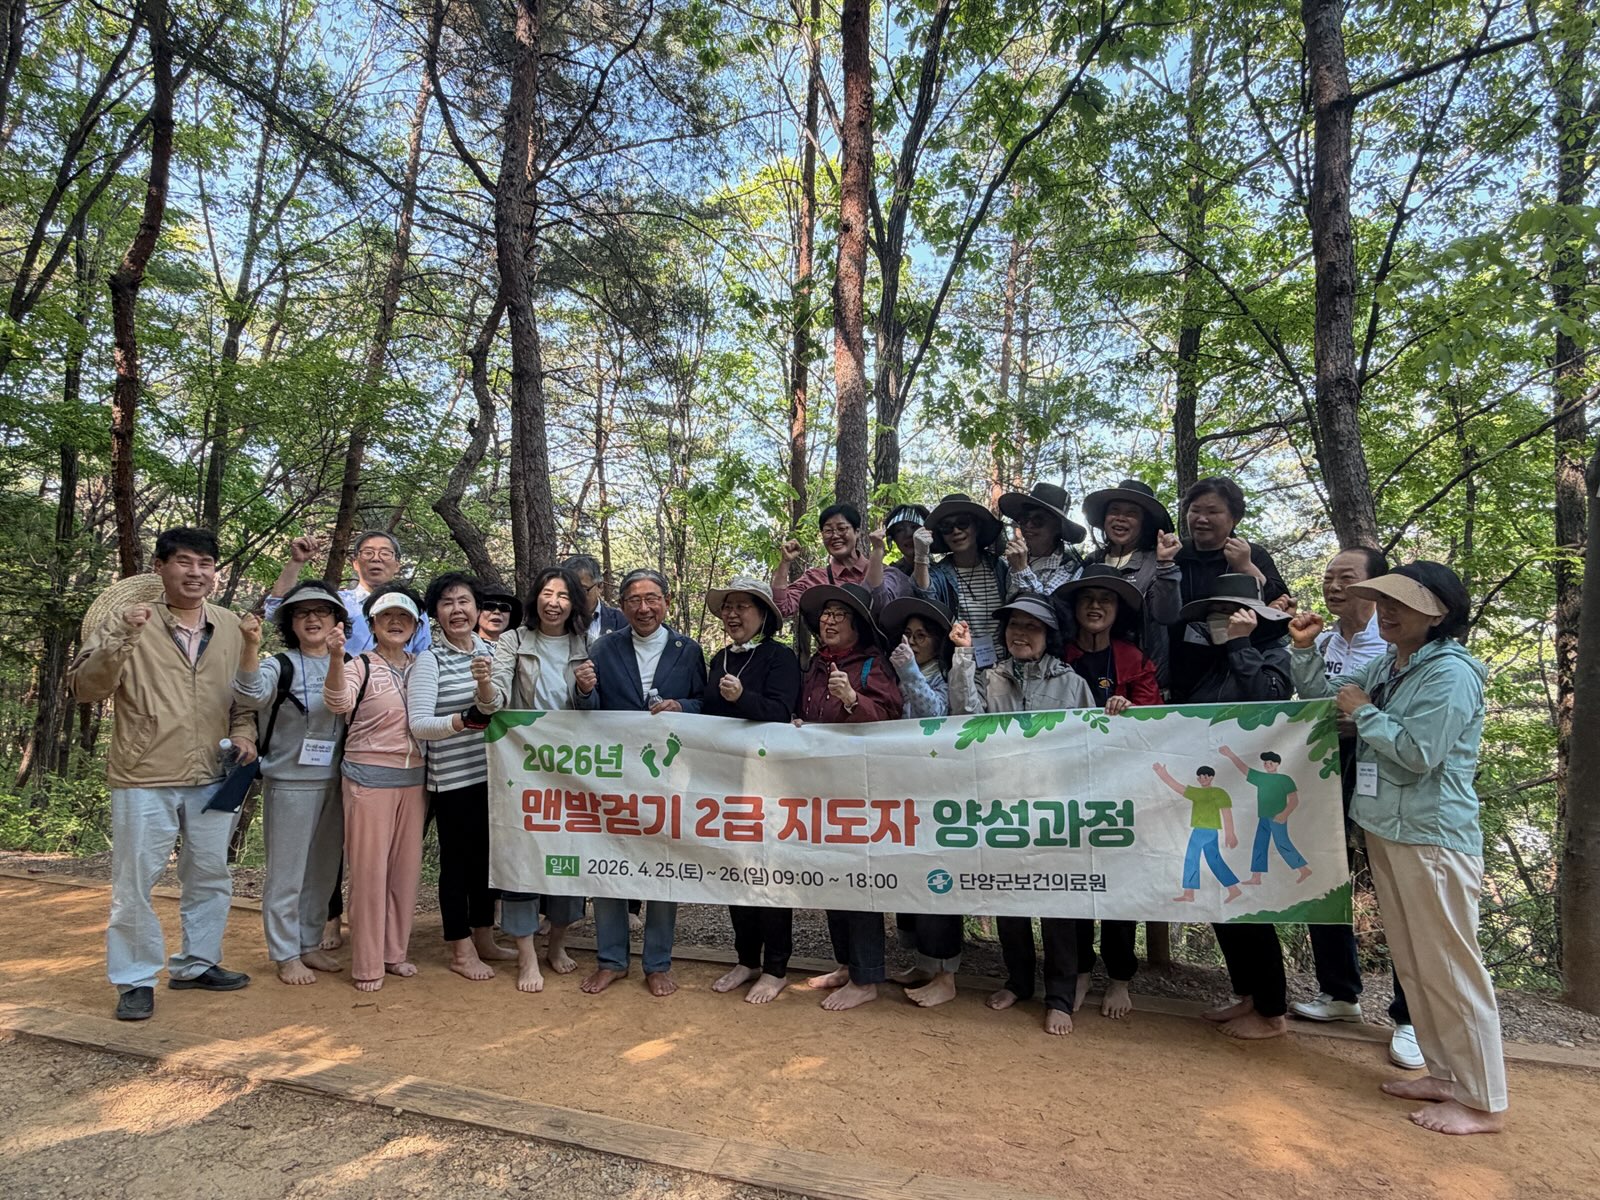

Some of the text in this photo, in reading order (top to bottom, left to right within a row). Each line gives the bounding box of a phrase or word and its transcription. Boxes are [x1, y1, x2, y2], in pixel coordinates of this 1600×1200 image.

[522, 743, 624, 779] 2026년
[521, 788, 1136, 849] 맨발걷기 2급 지도자 양성과정
[550, 857, 575, 875] 일시
[587, 859, 633, 877] 2026.
[637, 861, 652, 878] 4.
[772, 869, 824, 887] 09:00
[845, 872, 898, 890] 18:00
[959, 873, 1107, 893] 단양군보건의료원
